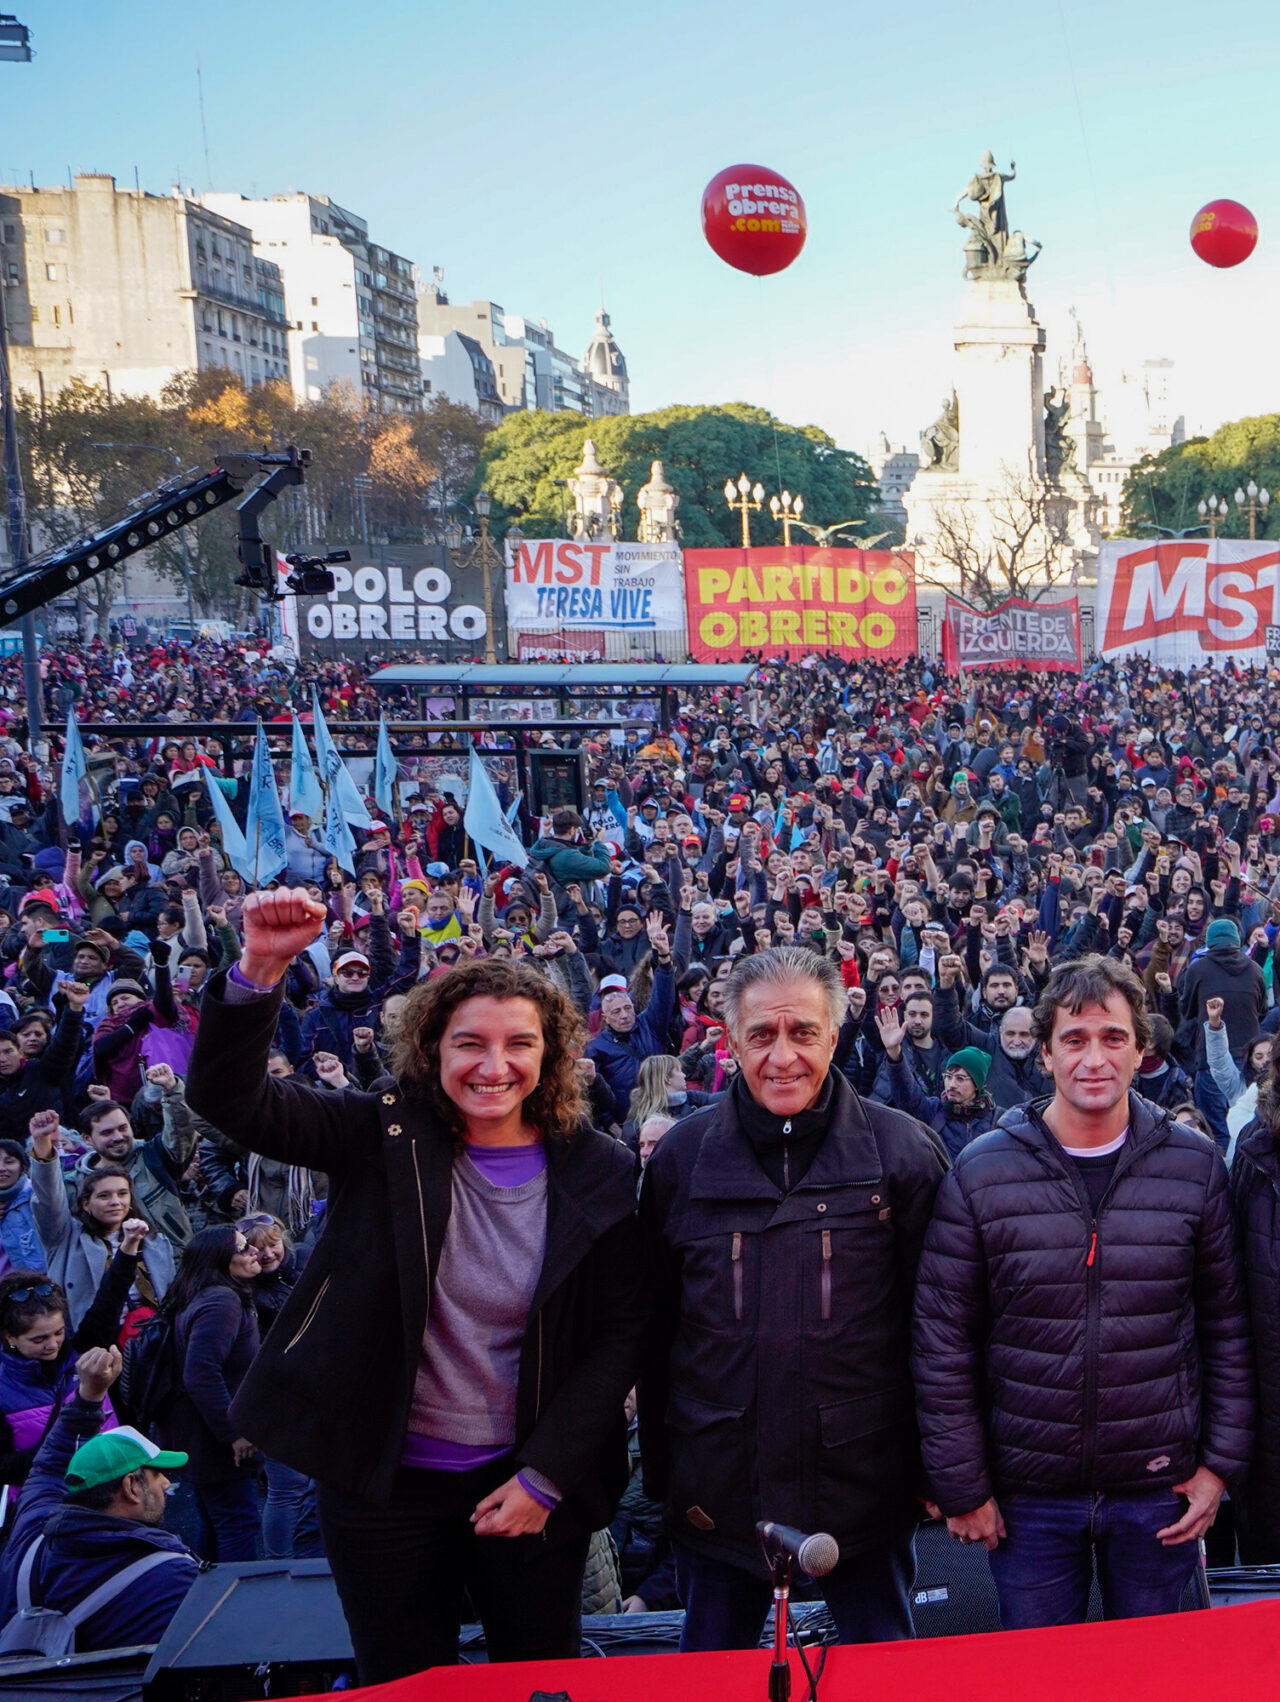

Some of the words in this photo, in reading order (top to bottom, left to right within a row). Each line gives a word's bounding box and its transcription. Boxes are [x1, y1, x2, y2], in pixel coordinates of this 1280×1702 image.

[725, 183, 798, 204] Prensa
[730, 218, 780, 232] .com
[513, 542, 611, 586] MST
[615, 551, 677, 562] MOVIMIENTO
[614, 565, 631, 575] SIN
[326, 566, 451, 603] POLO
[613, 578, 655, 588] TRABAJO
[698, 565, 909, 605] PARTIDO
[537, 586, 603, 619] TERESA
[610, 588, 652, 620] VIVE
[307, 603, 487, 641] OBRERO
[699, 609, 896, 649] OBRERO
[960, 609, 1040, 634] FRENTE
[1041, 617, 1067, 633] DE
[959, 630, 1075, 653] IZQUIERDA
[915, 1591, 928, 1604] dB
